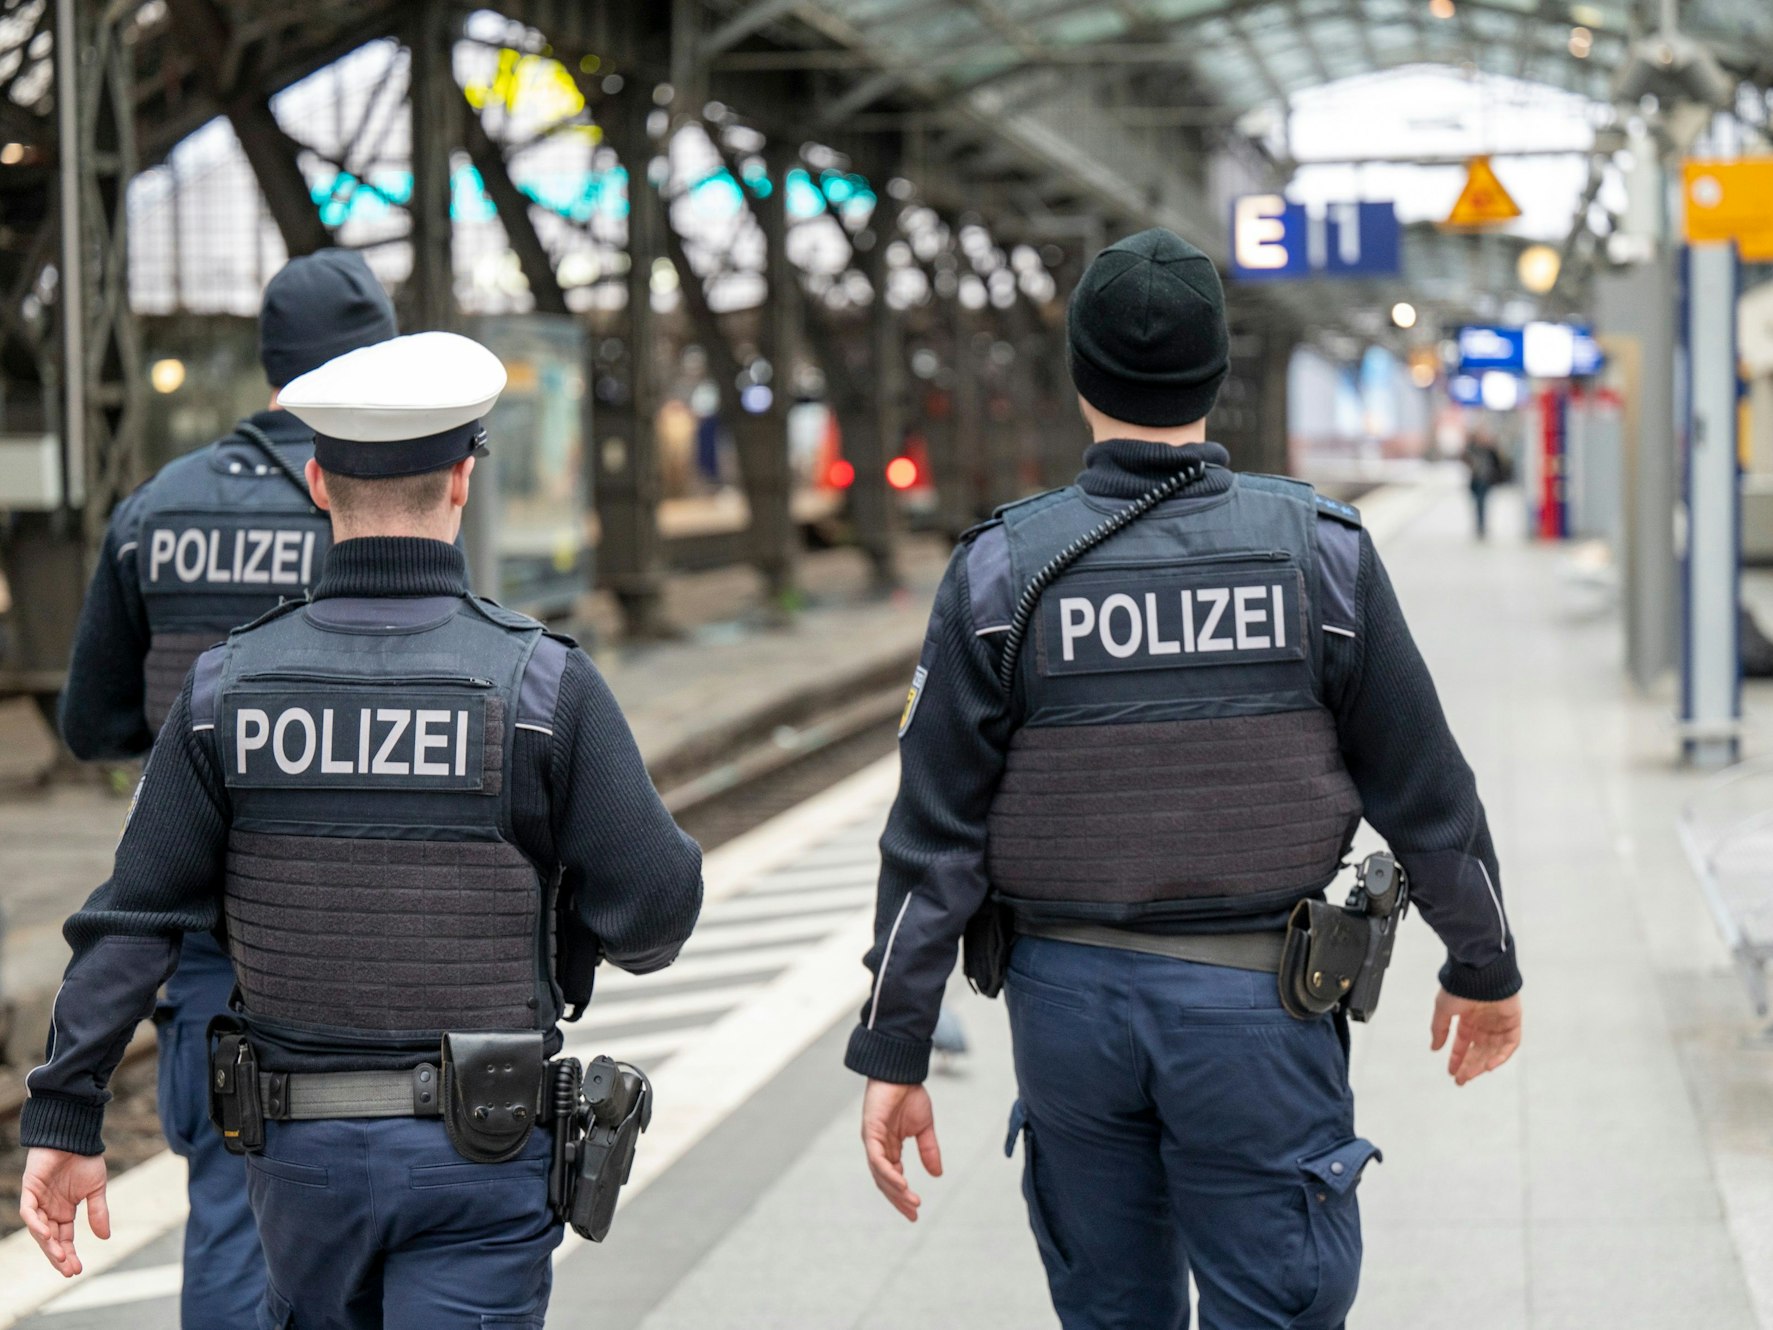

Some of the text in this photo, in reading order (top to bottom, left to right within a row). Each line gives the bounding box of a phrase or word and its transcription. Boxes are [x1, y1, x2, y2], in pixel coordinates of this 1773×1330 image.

[1235, 194, 1288, 270] E
[150, 528, 316, 585] POLIZEI
[1059, 584, 1287, 661] POLIZEI
[236, 706, 469, 777] POLIZEI
